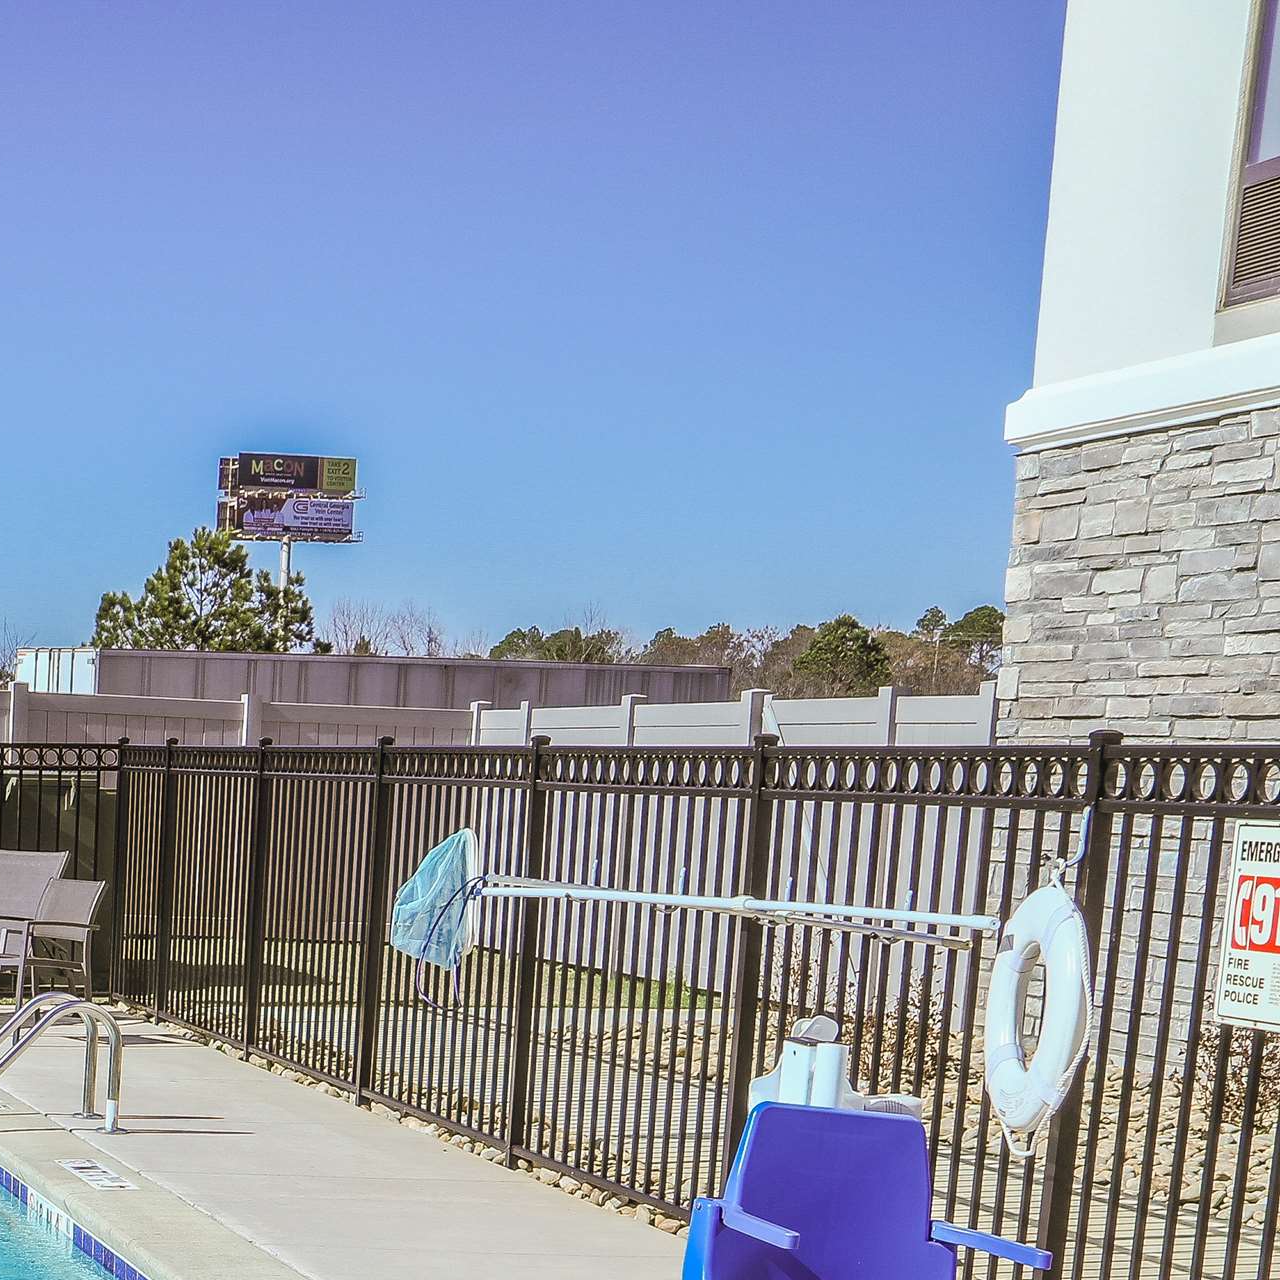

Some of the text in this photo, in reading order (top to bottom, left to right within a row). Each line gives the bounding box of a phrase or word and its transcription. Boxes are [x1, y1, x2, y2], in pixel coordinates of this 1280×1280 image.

[342, 462, 350, 475] 2
[1228, 957, 1250, 970] FIRE
[1225, 973, 1265, 989] RESCUE
[1224, 990, 1259, 1005] POLICE
